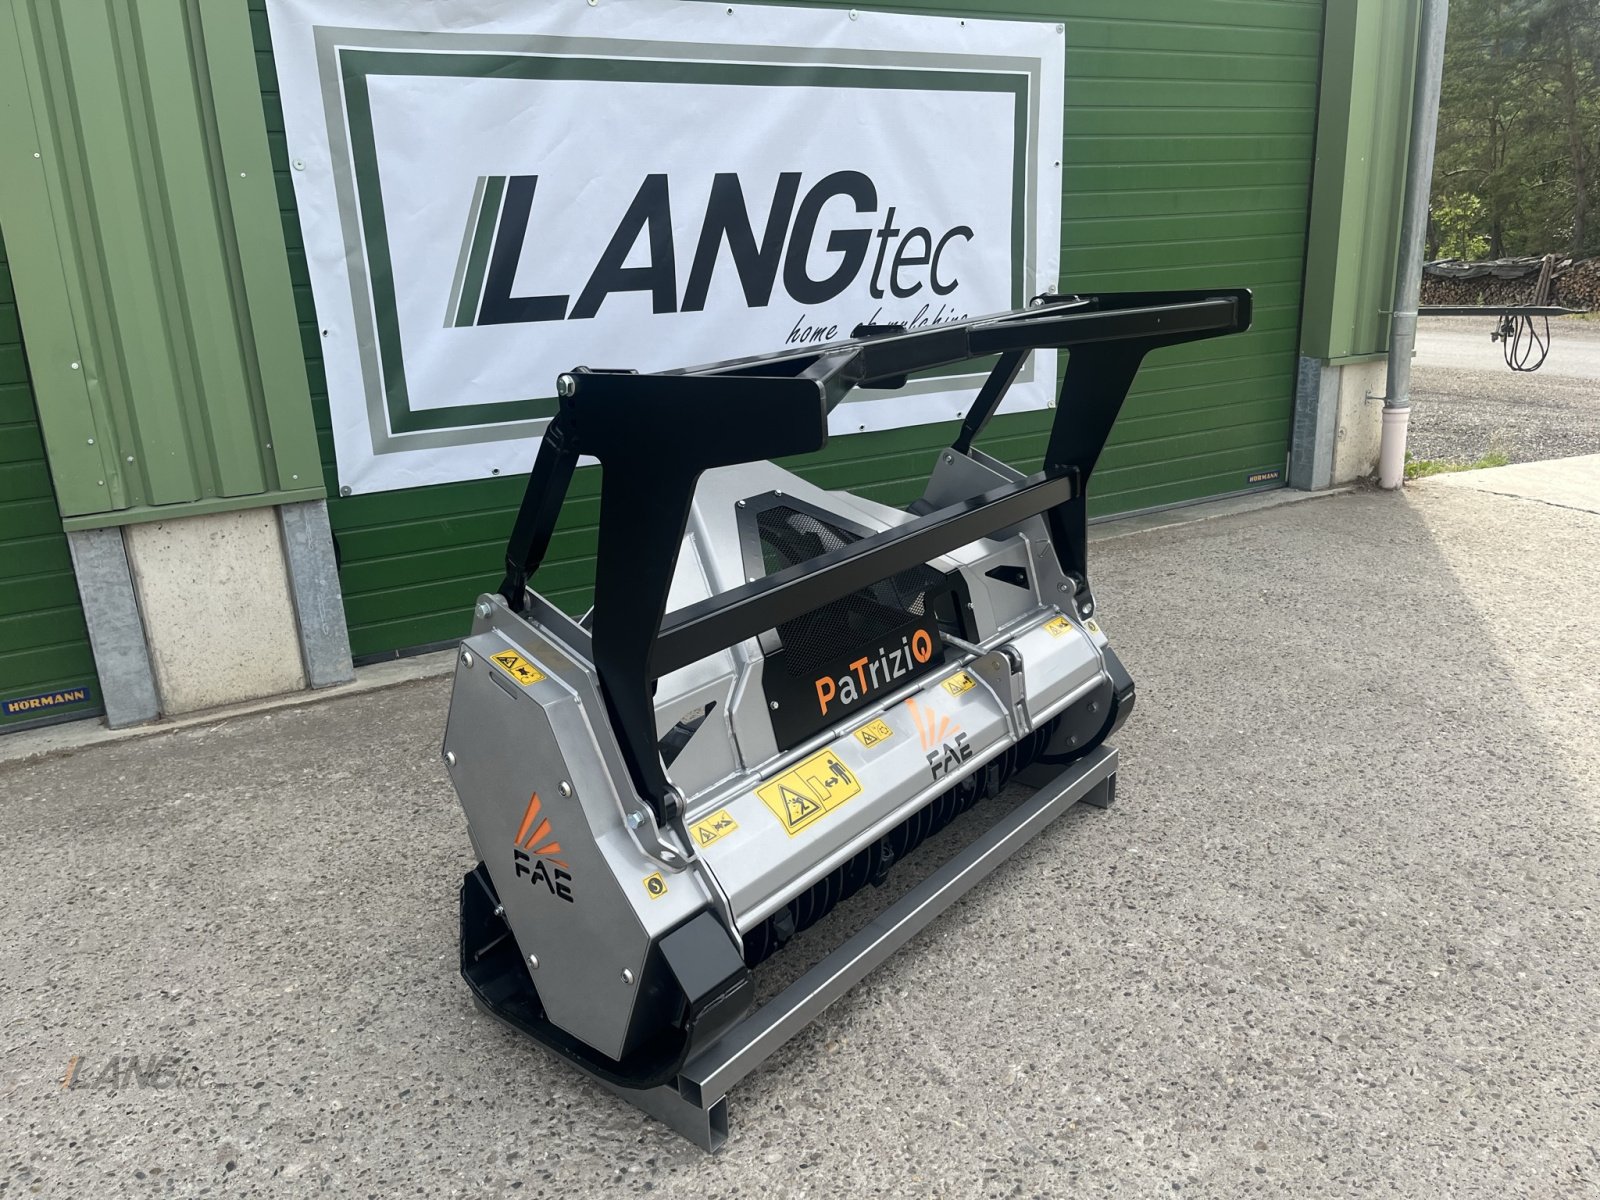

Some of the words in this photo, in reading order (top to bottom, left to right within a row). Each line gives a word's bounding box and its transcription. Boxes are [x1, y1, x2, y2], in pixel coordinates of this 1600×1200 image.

[476, 170, 975, 326] LANGtec
[785, 314, 838, 345] home
[926, 731, 973, 780] FAE
[513, 849, 574, 903] FAE
